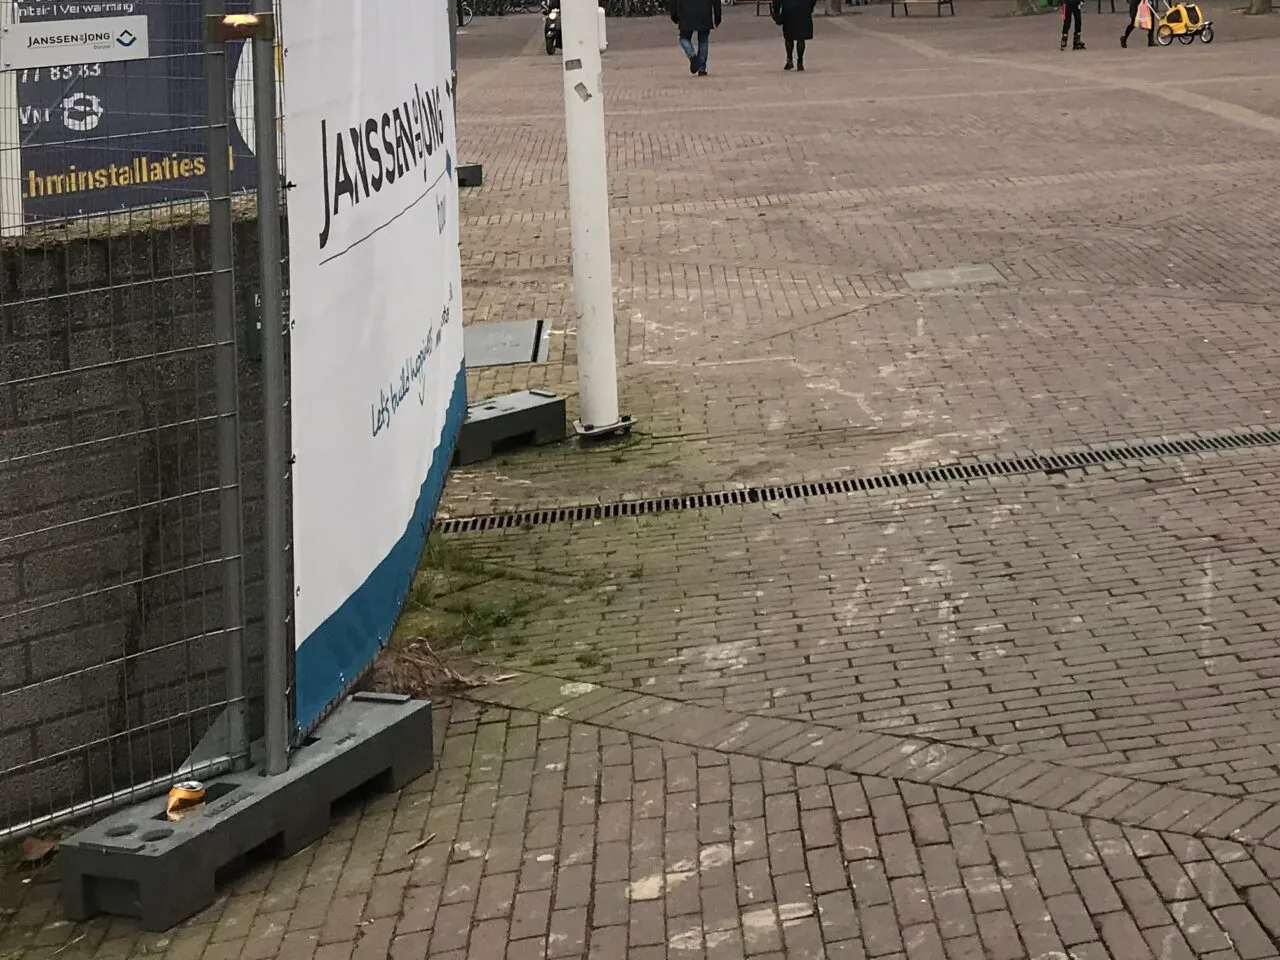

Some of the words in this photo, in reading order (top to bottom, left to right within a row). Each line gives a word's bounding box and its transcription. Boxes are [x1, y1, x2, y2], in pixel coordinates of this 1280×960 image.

[18, 4, 51, 17] nitair
[27, 34, 79, 48] JANSSEN
[83, 32, 111, 44] JONG
